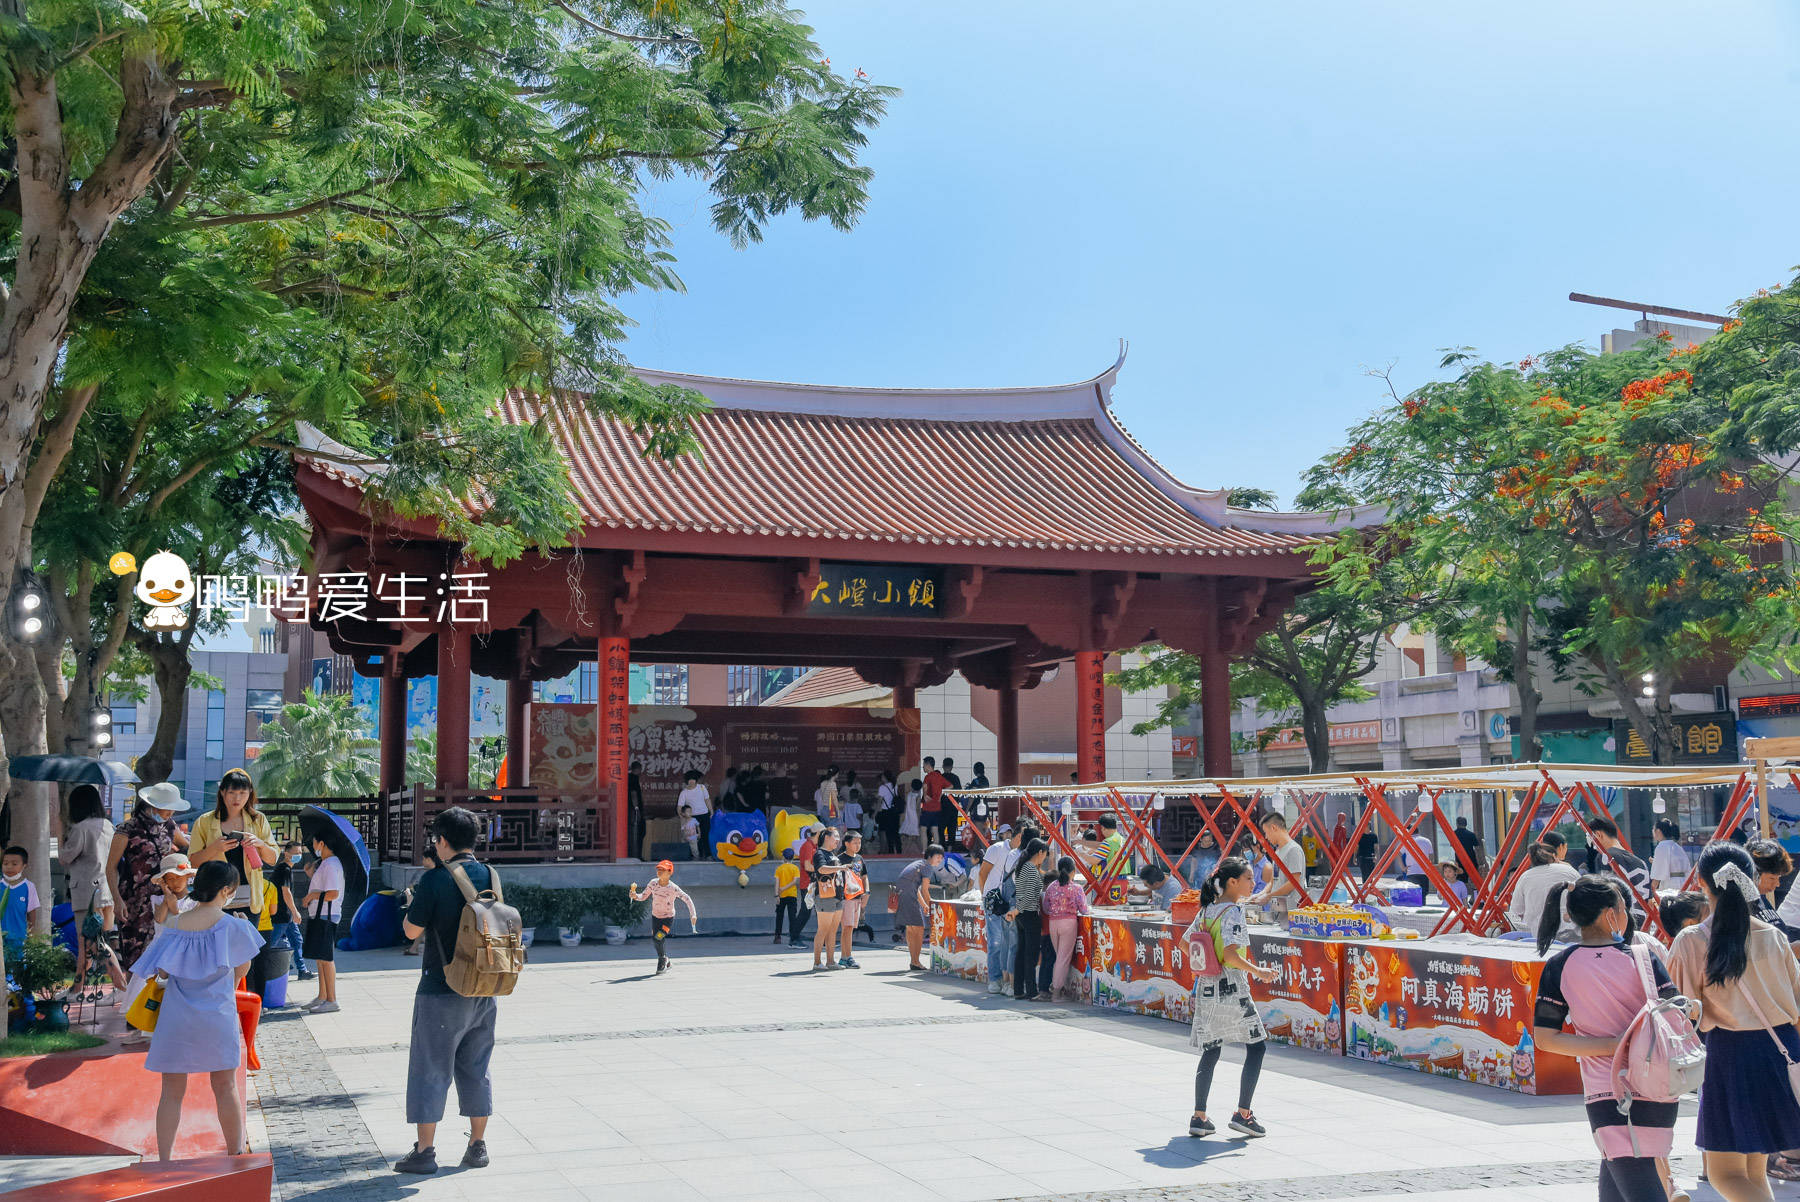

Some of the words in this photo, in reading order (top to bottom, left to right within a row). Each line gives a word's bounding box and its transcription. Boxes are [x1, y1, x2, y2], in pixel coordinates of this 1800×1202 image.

[1401, 976, 1515, 1020] 阿真海蛎饼
